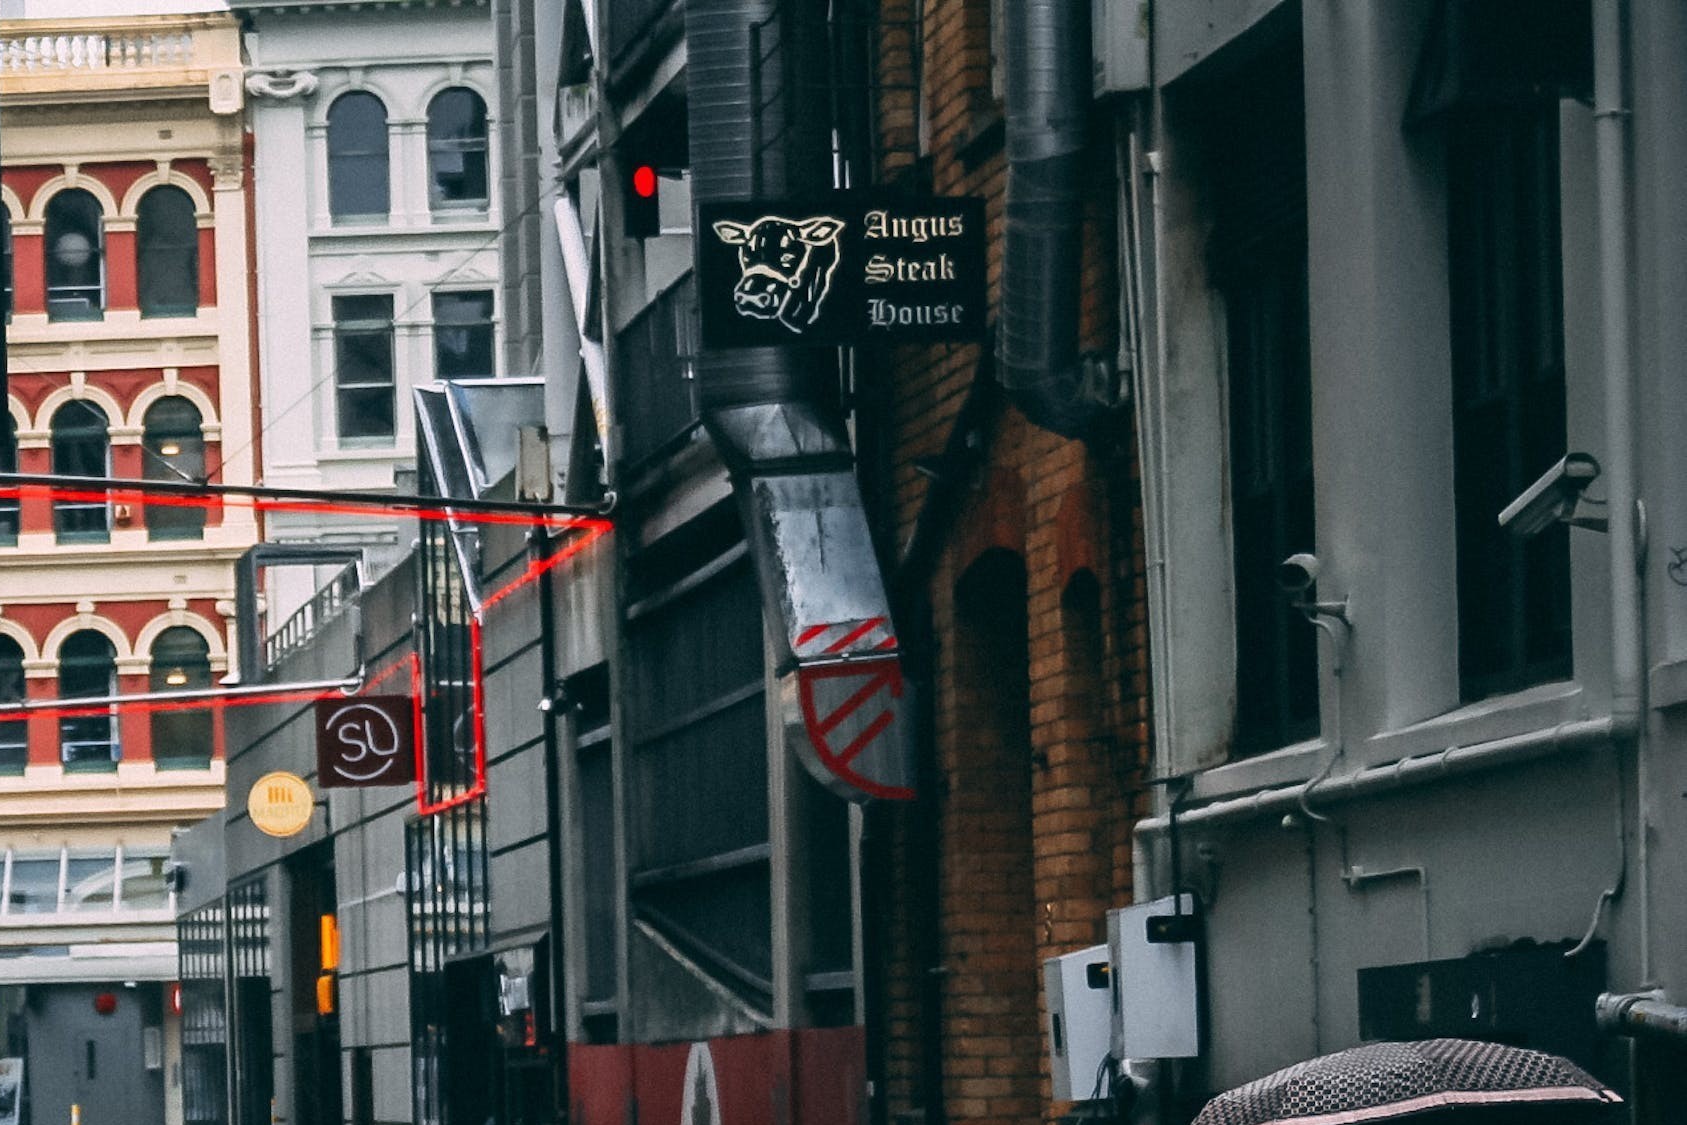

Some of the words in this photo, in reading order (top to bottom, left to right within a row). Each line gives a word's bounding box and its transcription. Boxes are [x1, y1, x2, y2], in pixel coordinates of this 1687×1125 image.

[863, 209, 964, 243] Angus
[864, 252, 956, 284] Steak
[867, 298, 964, 331] House
